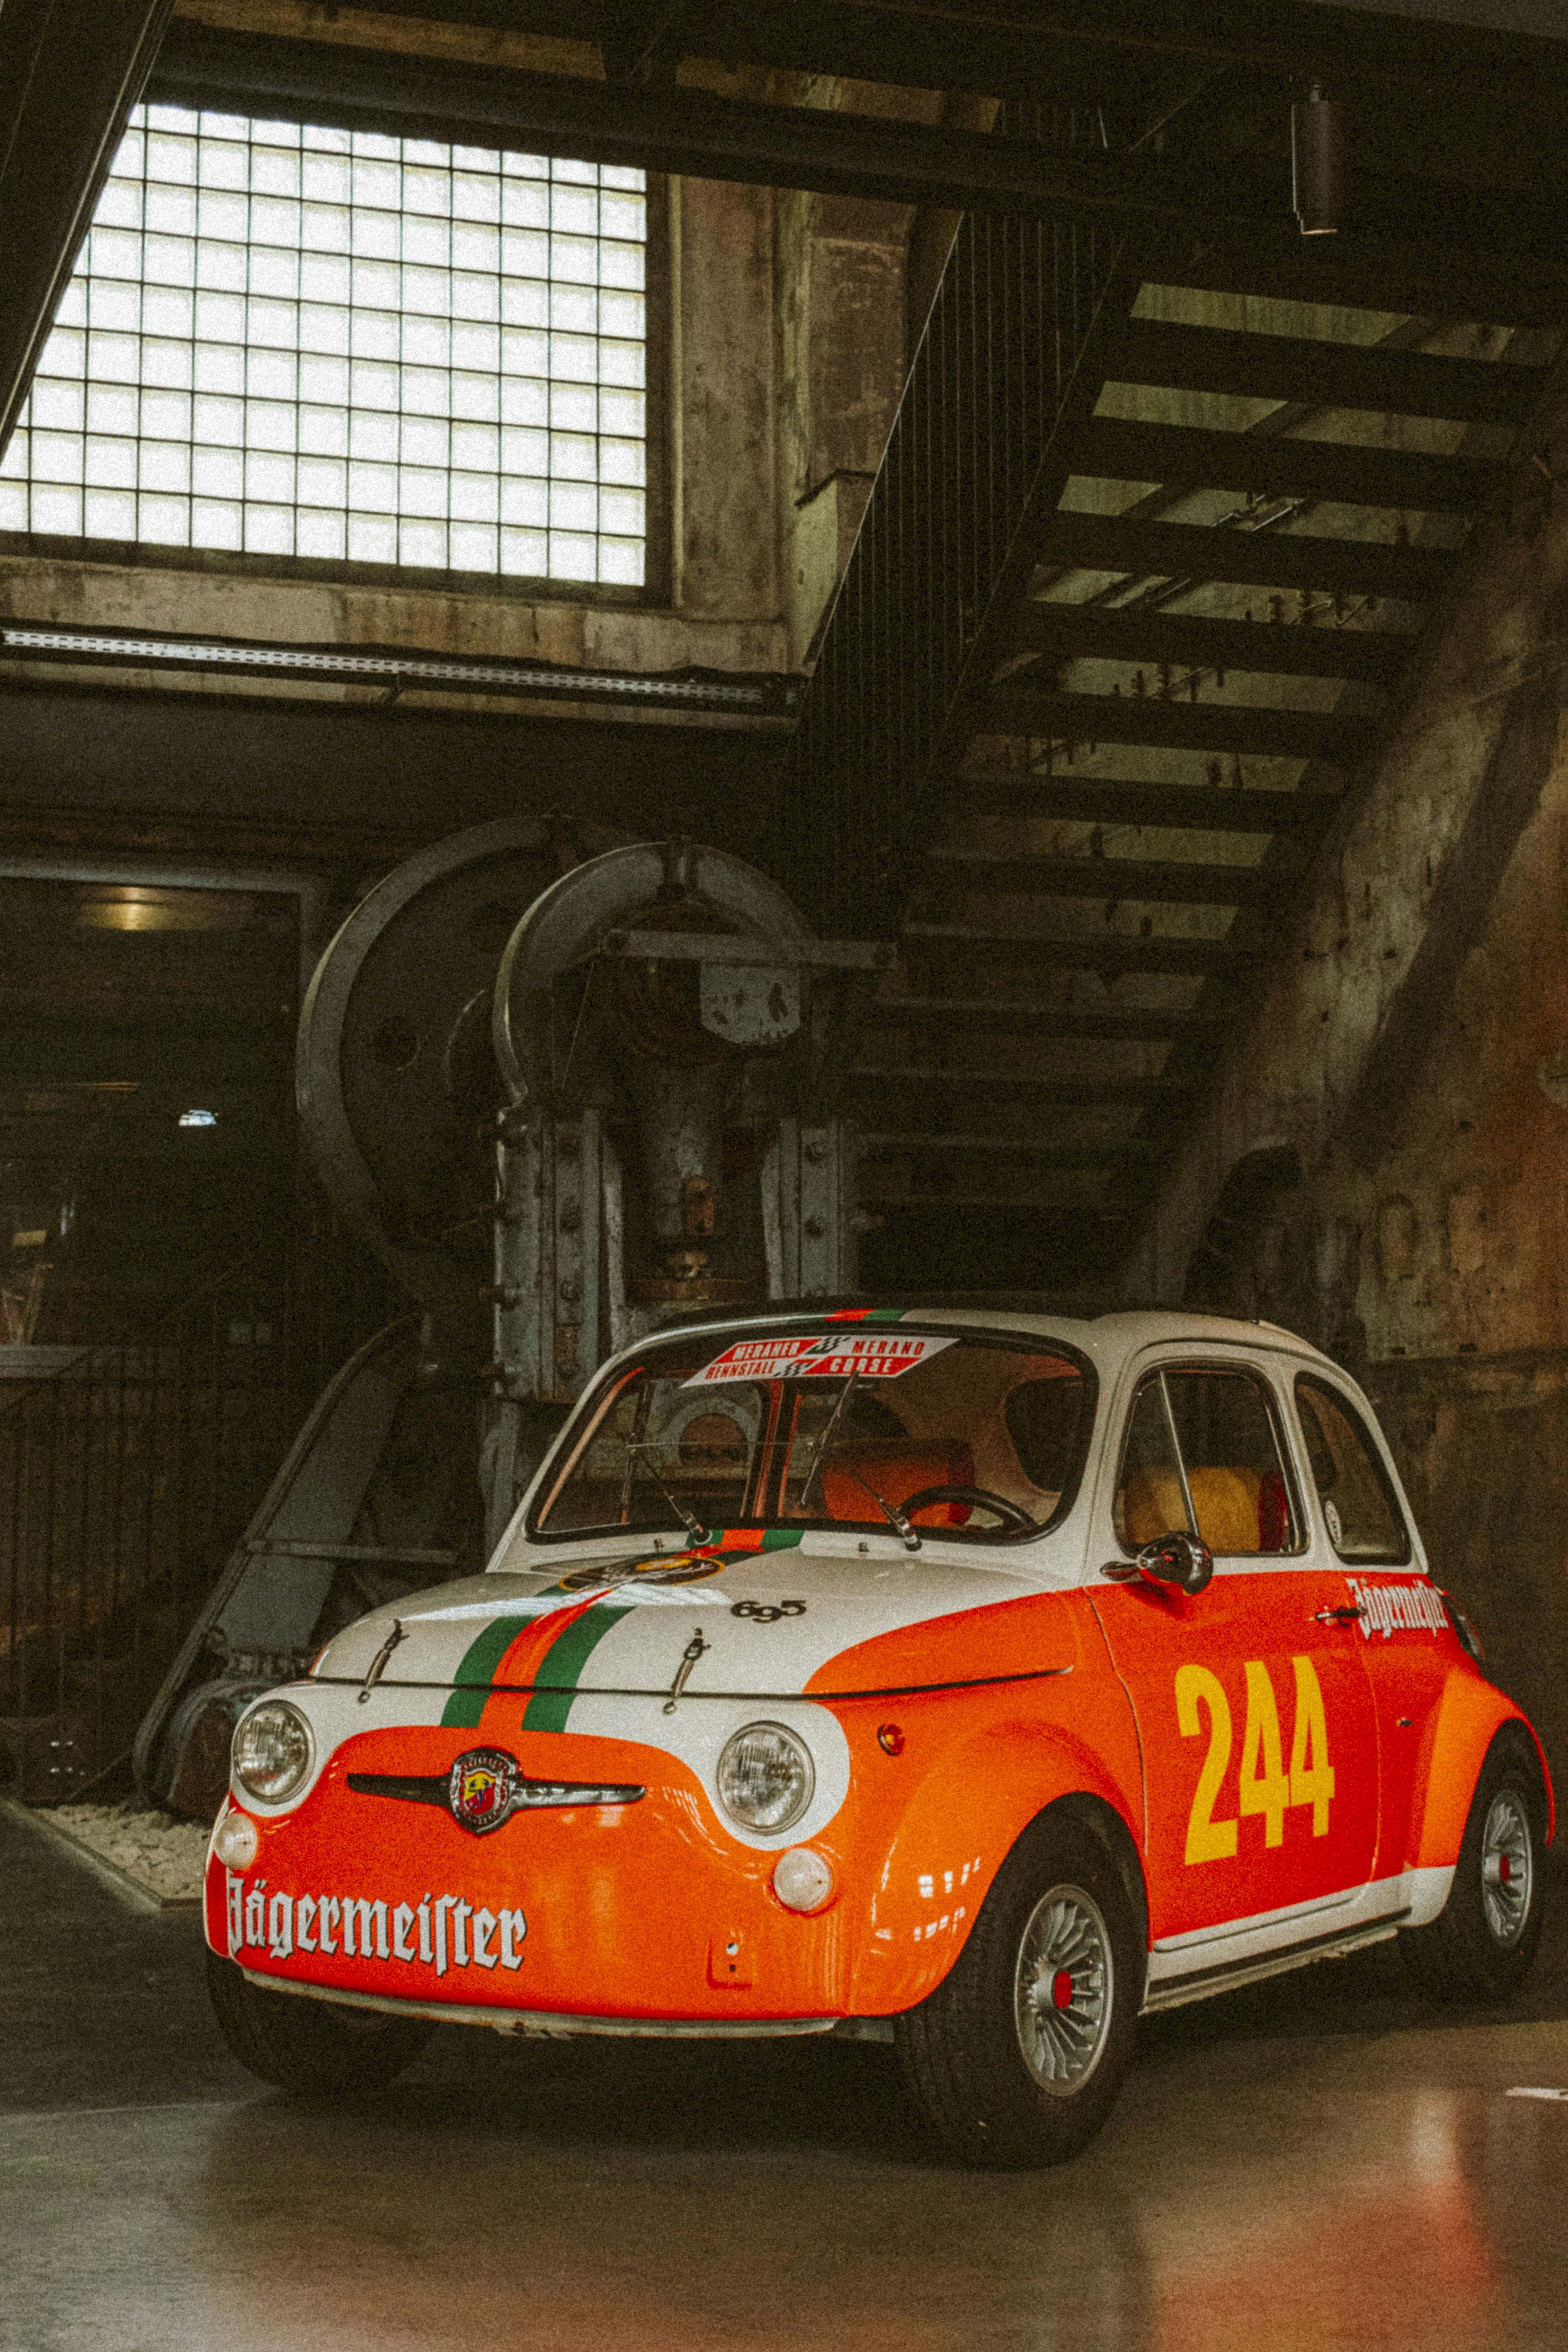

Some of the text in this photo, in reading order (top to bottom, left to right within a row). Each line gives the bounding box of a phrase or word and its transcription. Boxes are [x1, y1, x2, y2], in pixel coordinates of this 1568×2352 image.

[732, 1342, 801, 1361] MERANER
[852, 1340, 926, 1355] MERANO
[705, 1361, 776, 1380] RENNSTALL
[829, 1358, 894, 1372] CORSE
[730, 1600, 807, 1623] 695
[1175, 1655, 1335, 1866] 244
